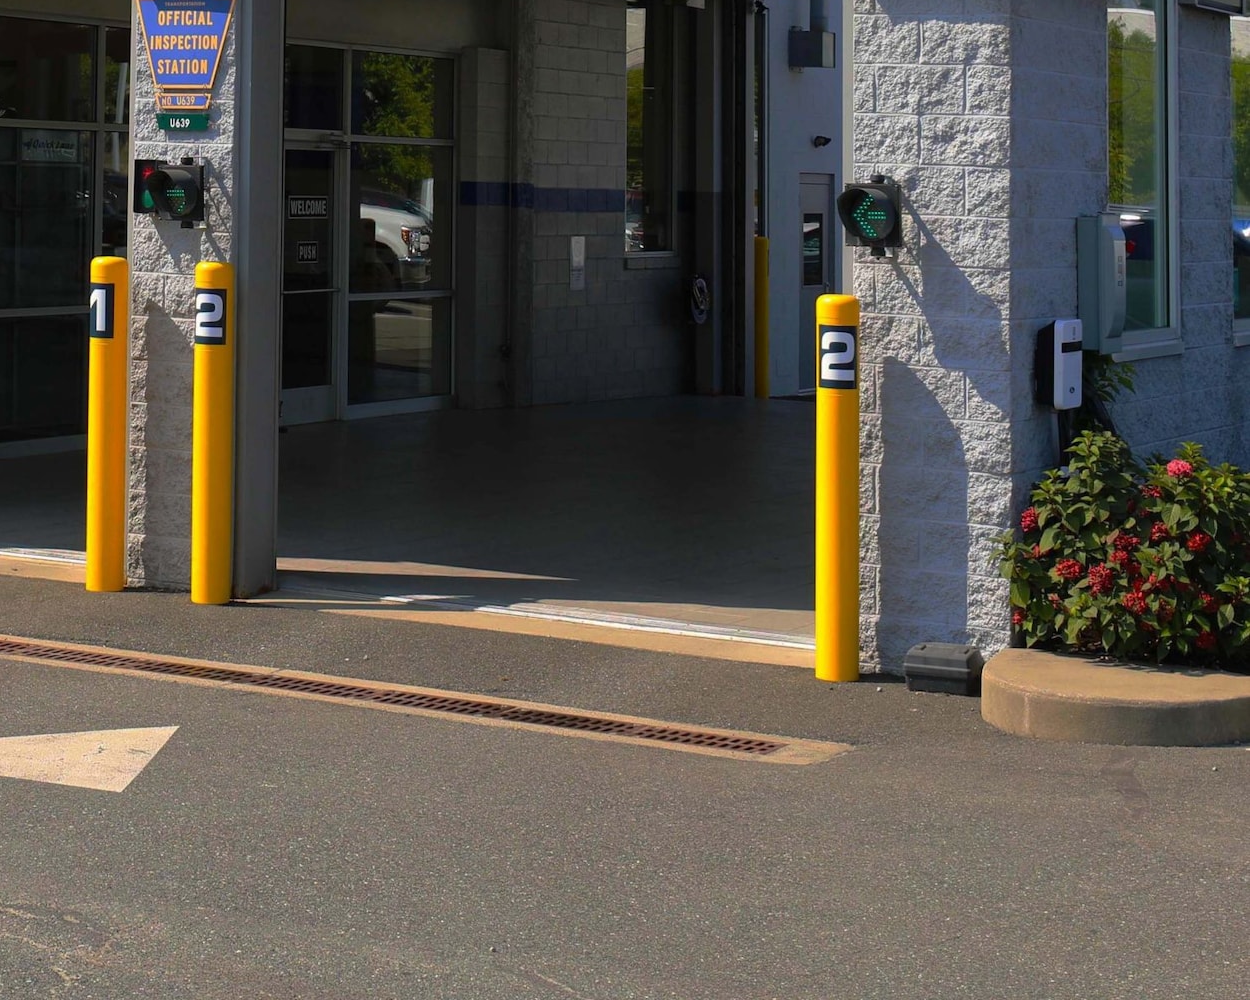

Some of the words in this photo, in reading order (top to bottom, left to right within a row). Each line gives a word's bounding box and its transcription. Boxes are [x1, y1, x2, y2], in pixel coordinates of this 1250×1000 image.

[158, 10, 213, 26] OFFICIAL
[150, 35, 218, 50] INSPECTION
[157, 59, 208, 75] STATION
[176, 96, 196, 106] U639
[170, 118, 190, 128] U639
[290, 200, 327, 216] WELCOME
[299, 245, 317, 260] PUSH
[90, 289, 107, 331] 1
[195, 293, 224, 338] 2
[821, 331, 855, 381] 2
